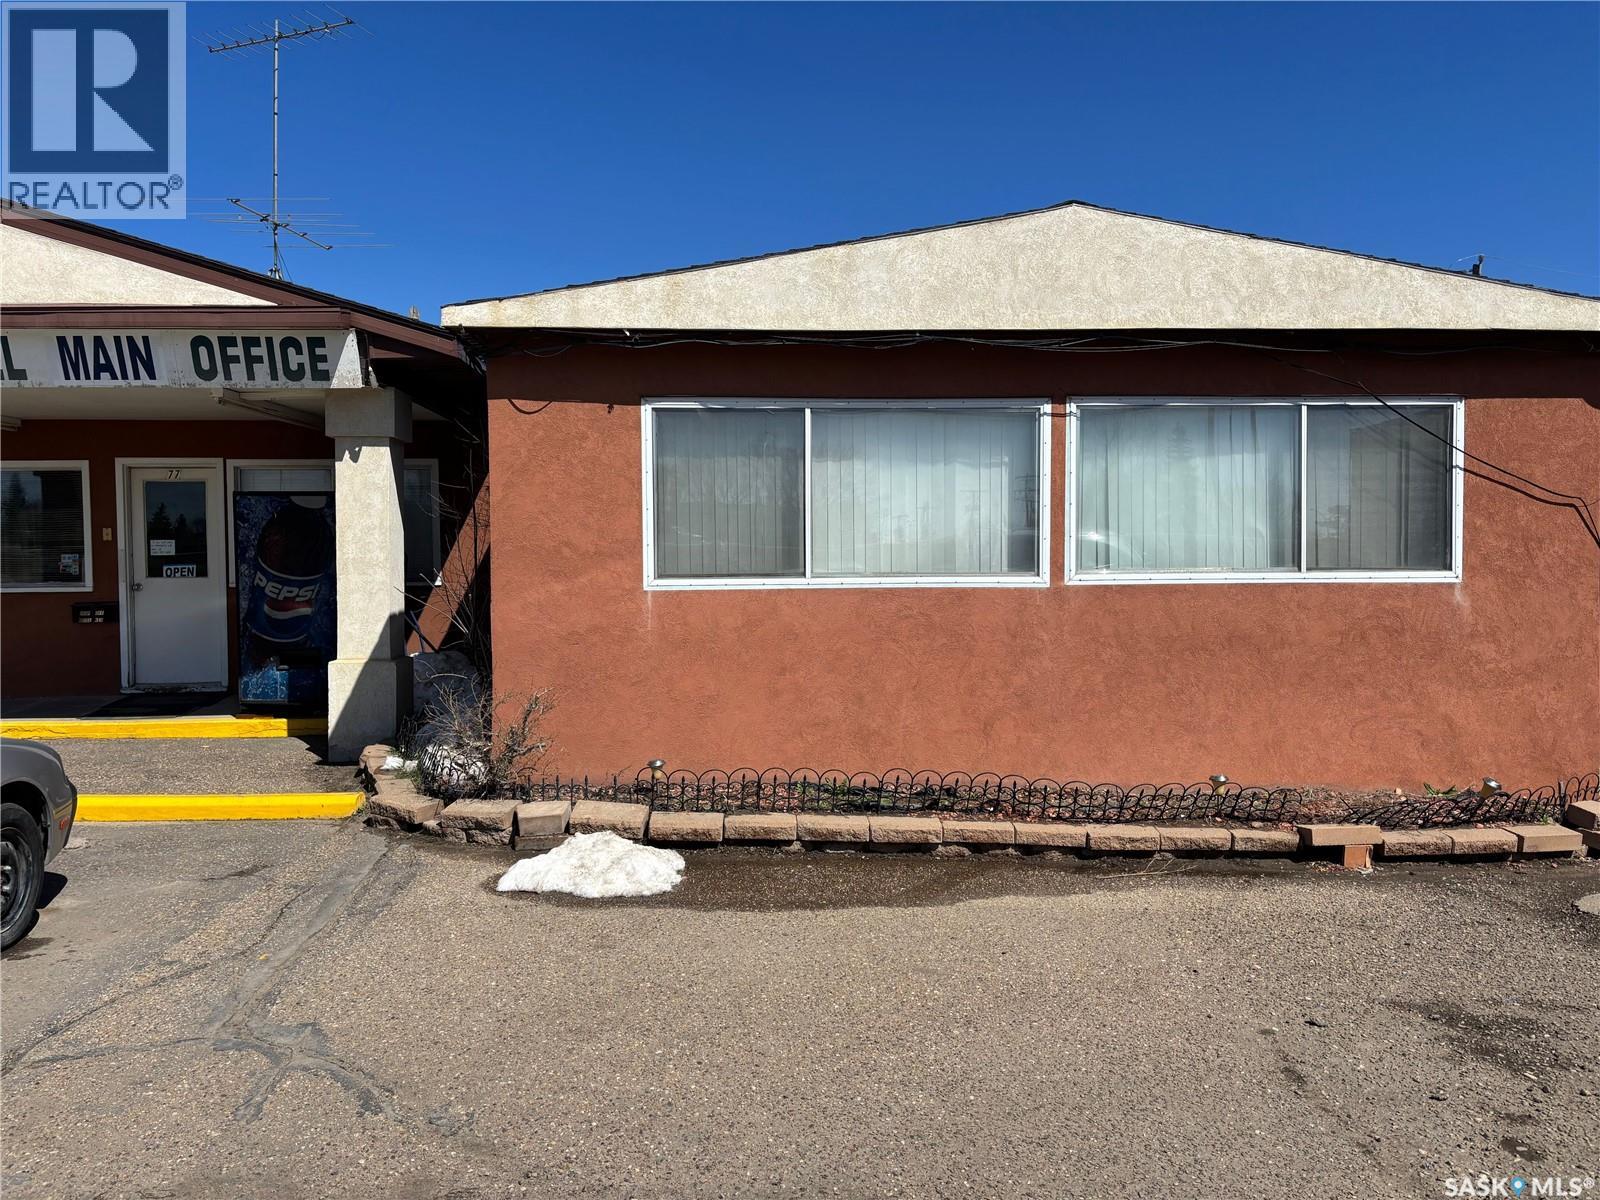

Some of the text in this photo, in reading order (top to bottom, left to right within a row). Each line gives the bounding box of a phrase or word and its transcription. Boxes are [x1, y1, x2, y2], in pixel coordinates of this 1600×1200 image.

[1, 335, 331, 382] L MAIN OFFICE
[168, 469, 181, 480] 77
[165, 566, 195, 578] OPEN
[253, 570, 320, 602] PEPSI
